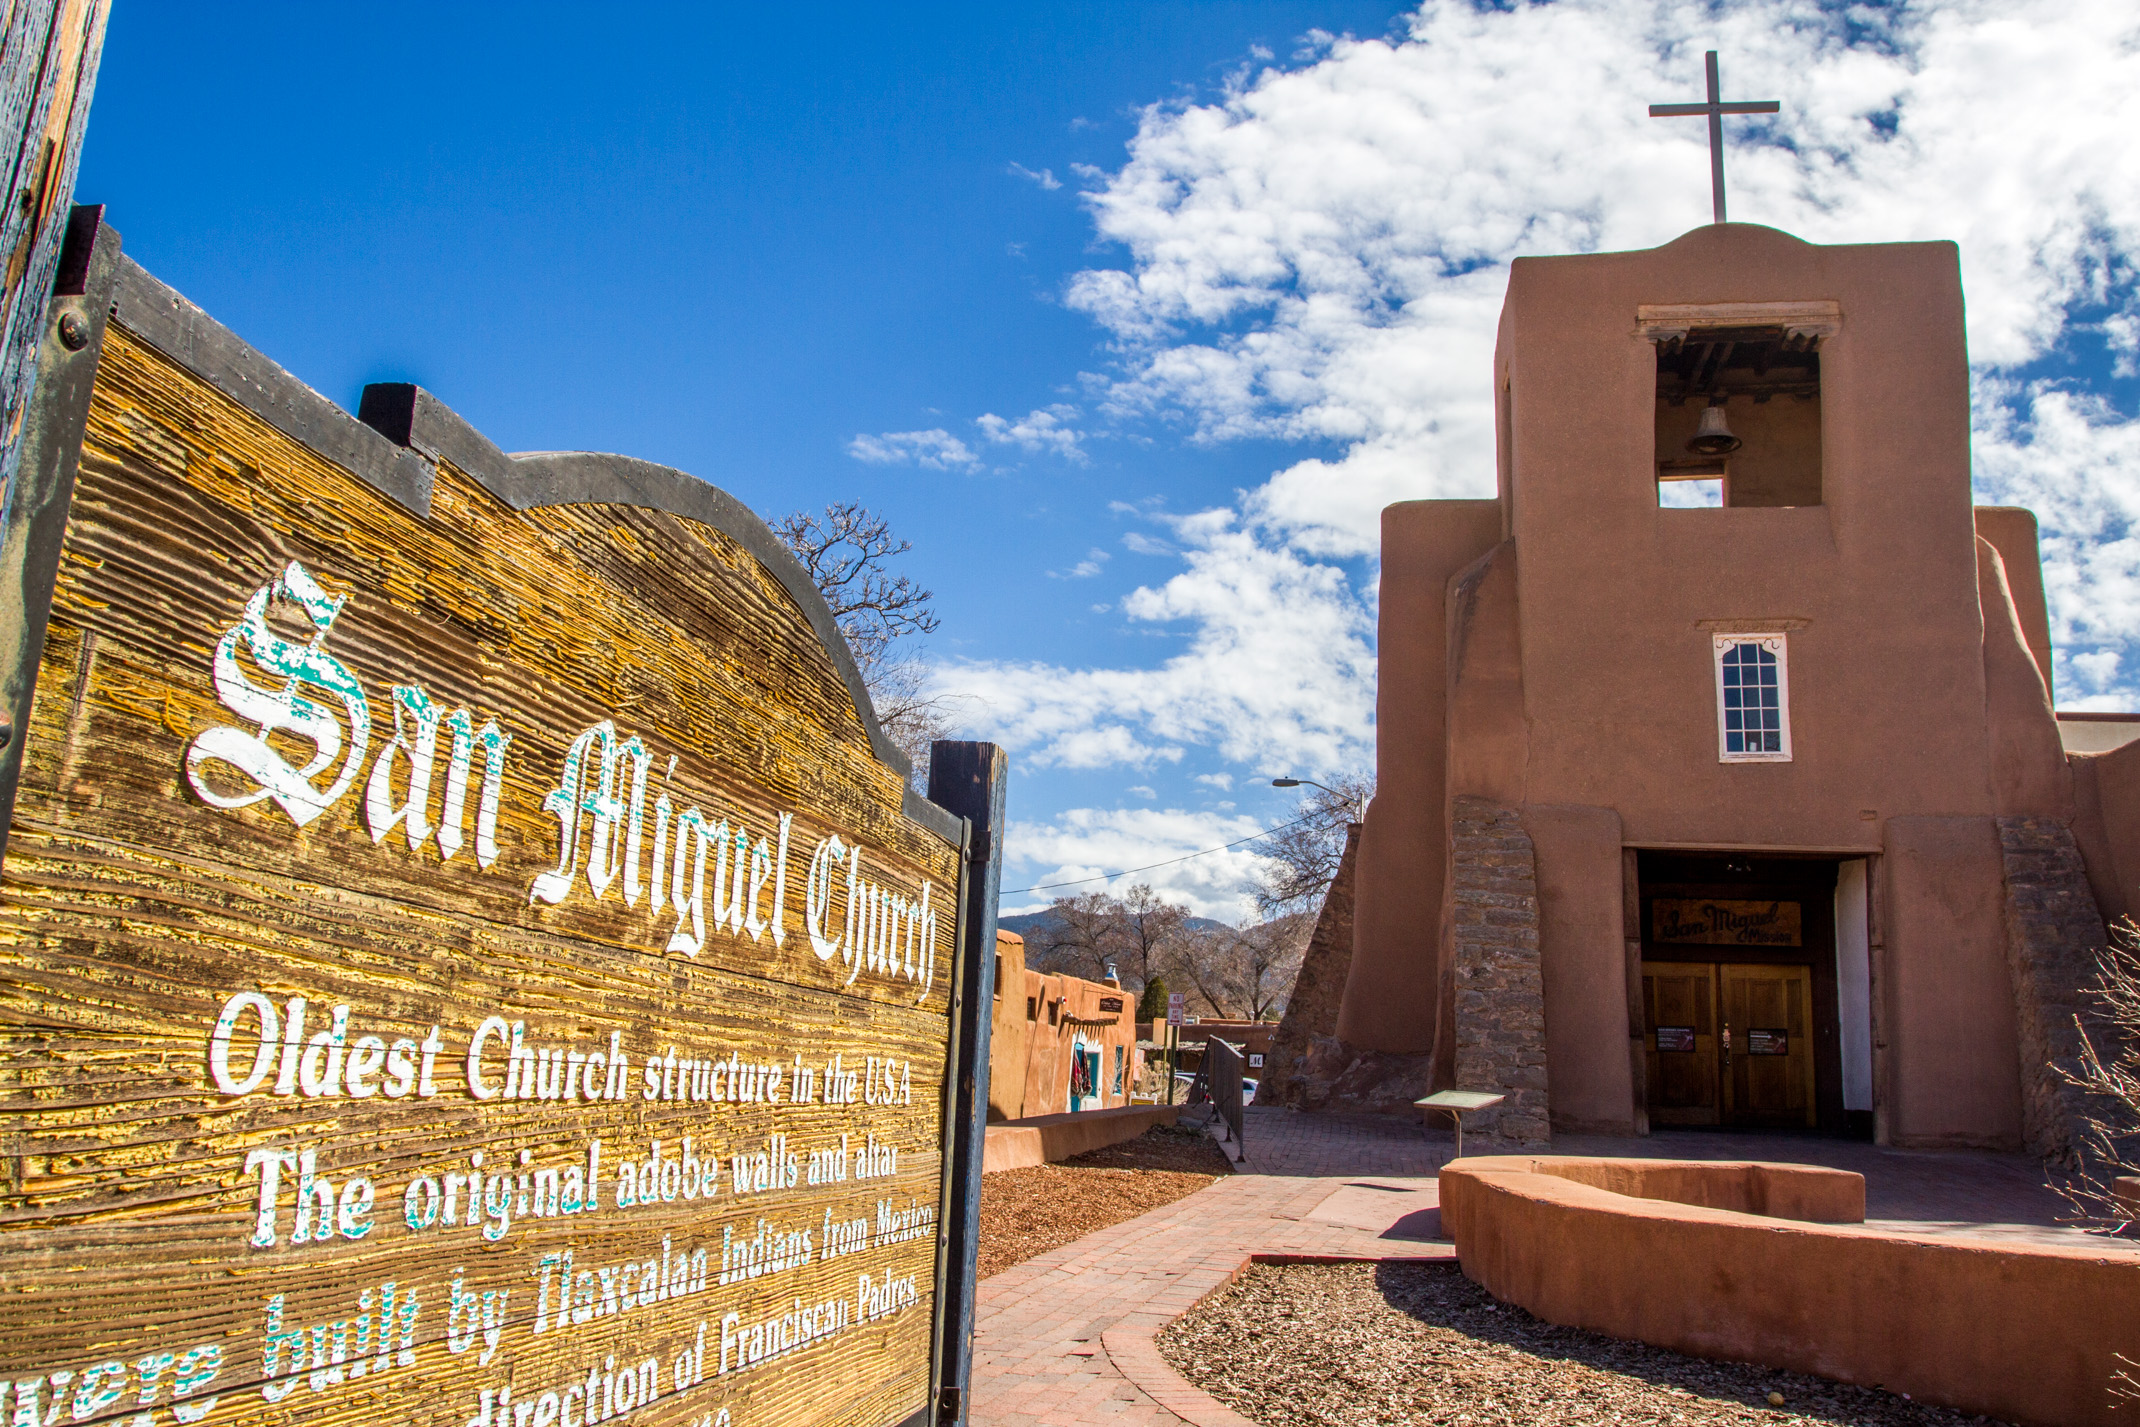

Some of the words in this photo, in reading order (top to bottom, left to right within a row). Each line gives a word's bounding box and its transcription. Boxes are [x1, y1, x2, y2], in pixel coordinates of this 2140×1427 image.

[186, 560, 513, 870] San
[529, 719, 794, 959] Miguel
[806, 834, 936, 1004] Church
[1662, 910, 1709, 938] San
[1703, 902, 1779, 943] Miguel
[210, 991, 444, 1098] Oldest
[467, 1015, 627, 1100] Church
[642, 1045, 783, 1102] structure
[789, 1053, 815, 1104] in
[823, 1053, 858, 1104] the
[245, 1148, 375, 1248] The
[404, 1138, 600, 1242] original
[616, 1135, 719, 1208] adobe
[732, 1133, 798, 1194] walls
[807, 1133, 848, 1186] and
[855, 1132, 899, 1180] altar
[261, 1281, 420, 1404] built
[448, 1266, 510, 1367] by
[529, 1232, 708, 1335] Tlaxcalan
[719, 1218, 812, 1286] Indians
[821, 1206, 868, 1260] from
[873, 1197, 933, 1248] Mexico
[673, 1320, 708, 1391] of
[717, 1297, 849, 1376] Franciscan
